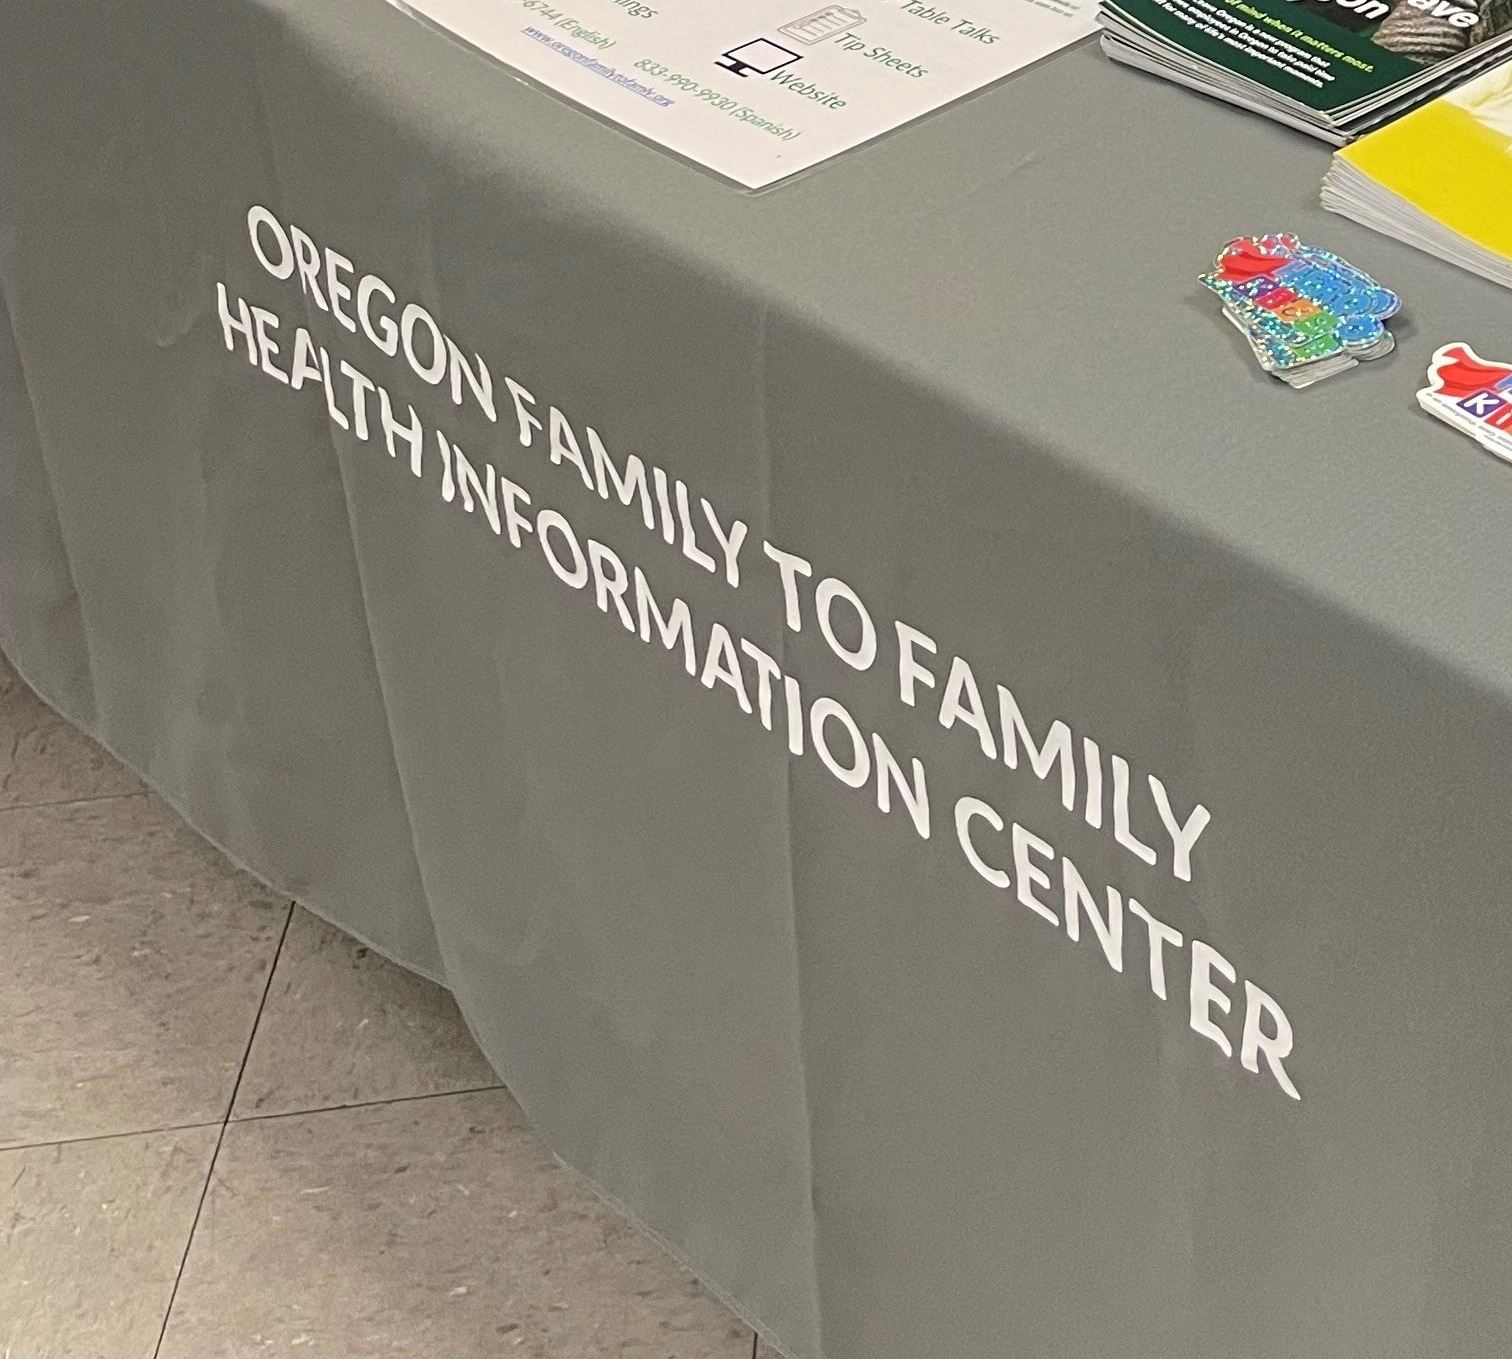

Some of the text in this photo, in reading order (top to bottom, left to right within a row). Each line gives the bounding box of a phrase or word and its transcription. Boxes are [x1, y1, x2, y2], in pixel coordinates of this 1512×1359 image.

[554, 16, 617, 49] (English)
[949, 19, 1000, 46] Talks
[834, 32, 928, 78] Tip Sheets
[770, 69, 847, 109] Website
[729, 104, 801, 141] (Spanish)
[247, 206, 1210, 882] OREGON FAMILY TO FAMILY
[217, 282, 1301, 1100] HEALTH INFORMATION CENTER
